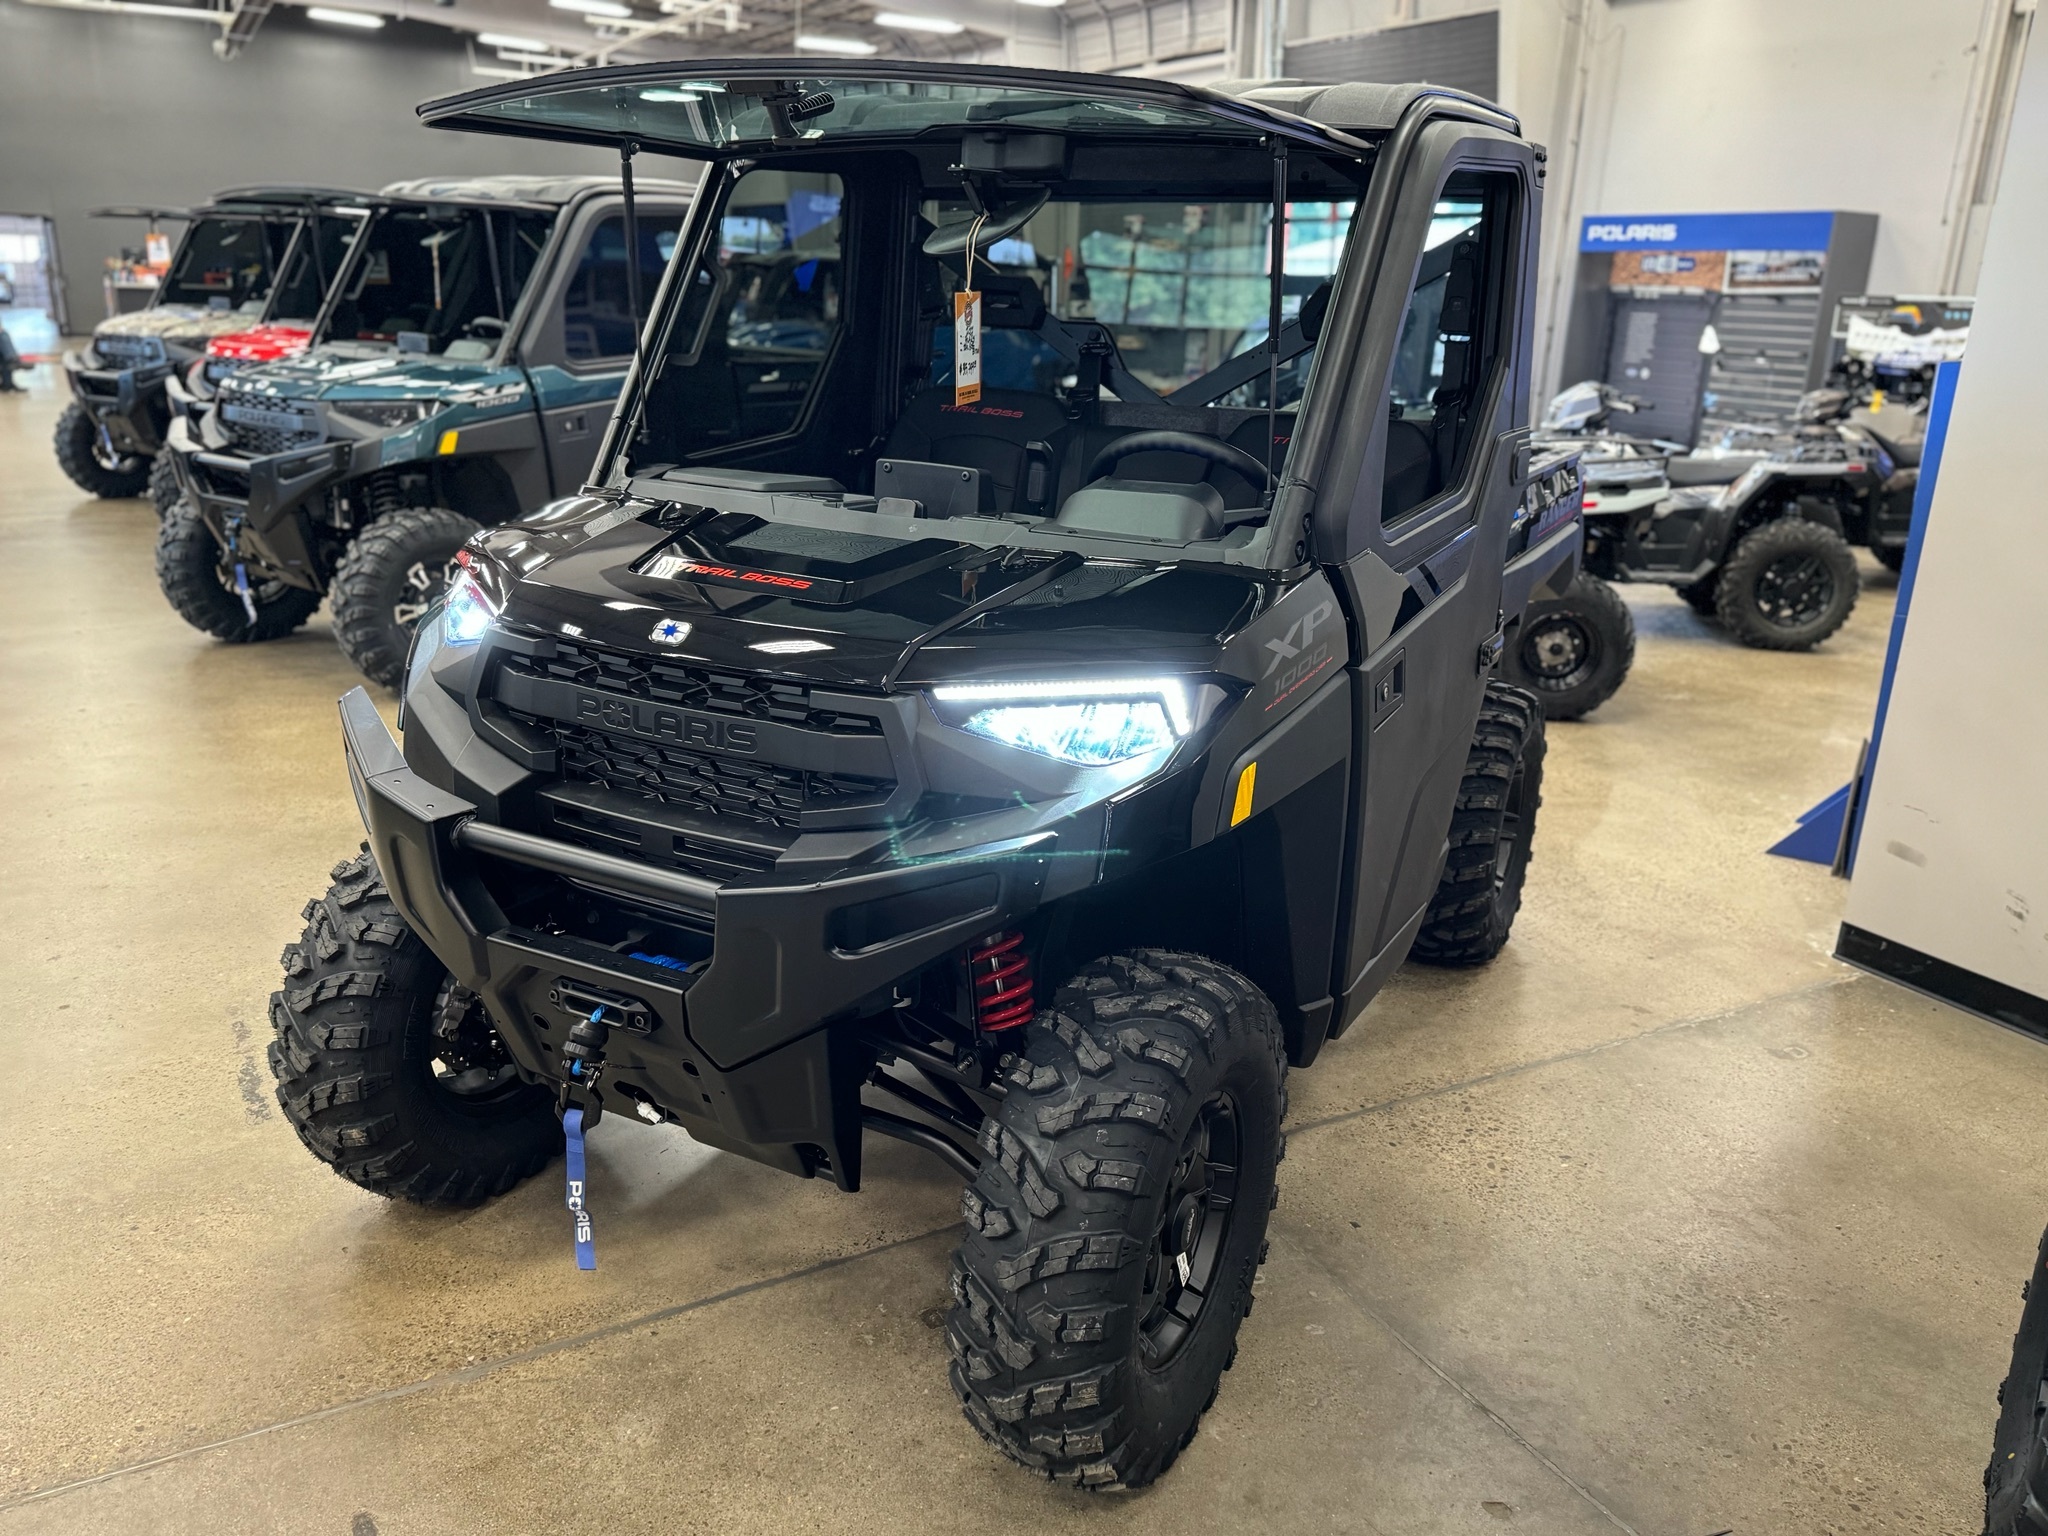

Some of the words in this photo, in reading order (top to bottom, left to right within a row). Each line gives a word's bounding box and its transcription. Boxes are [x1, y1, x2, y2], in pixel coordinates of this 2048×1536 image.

[1587, 223, 1678, 242] POLARIS
[941, 405, 977, 413] TRAIL
[981, 408, 1024, 418] BOSS
[677, 561, 738, 578] TRAIL
[740, 572, 813, 590] BOSS
[1261, 599, 1334, 681] XP
[1274, 642, 1328, 696] 1000
[576, 691, 758, 755] POLARIS
